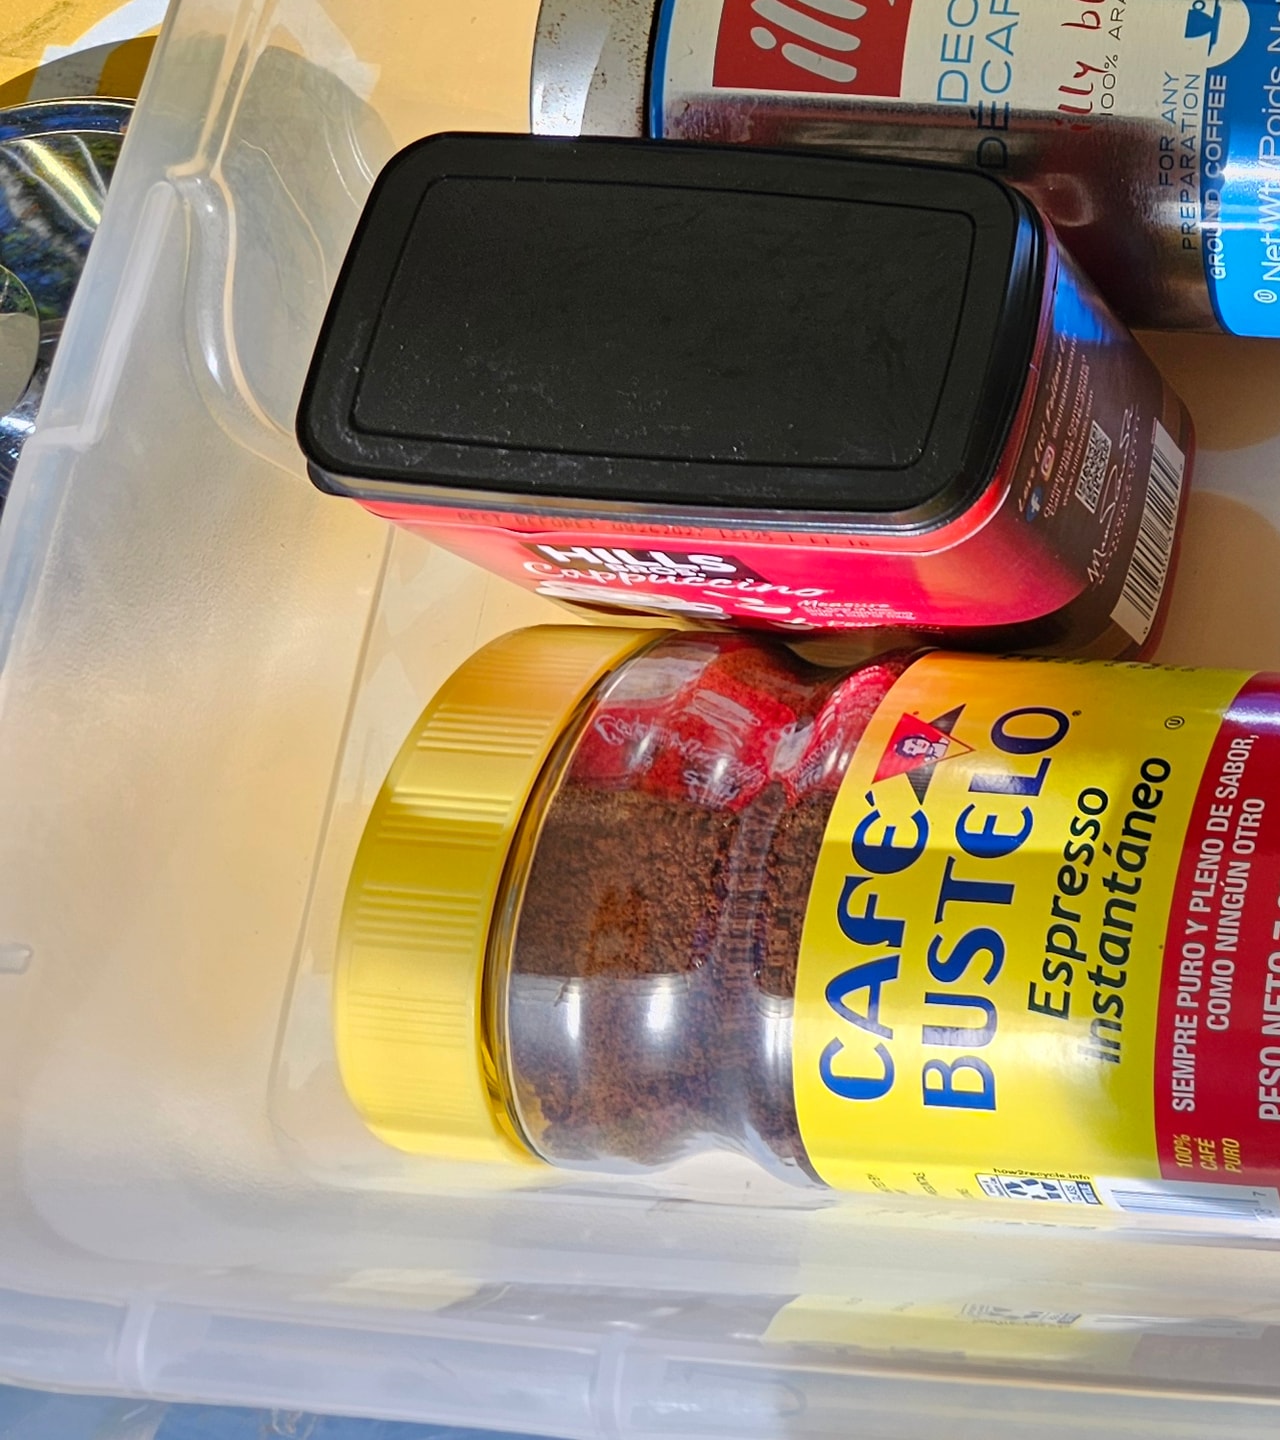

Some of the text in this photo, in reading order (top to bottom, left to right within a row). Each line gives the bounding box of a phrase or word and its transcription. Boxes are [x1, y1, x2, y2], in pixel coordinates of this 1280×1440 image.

[1056, 59, 1102, 133] illy
[1157, 70, 1181, 188] FOR ANY
[1179, 72, 1203, 253] PREPARATION
[1203, 72, 1229, 281] GROUND COFFEE
[522, 561, 828, 599] Cappuccino
[535, 543, 738, 575] HILLS
[818, 790, 931, 1103] CAFÉ
[920, 705, 1073, 1112] BUSTELO
[1026, 786, 1110, 1021] Espresso
[1078, 756, 1173, 1065] Instantáneo
[1171, 733, 1260, 1113] SIEMPRE PURO Y PLENO DE SABOR,
[1205, 796, 1267, 1033] COMO NINGÚN OTRO
[992, 1166, 1092, 1182] how2recycle.info
